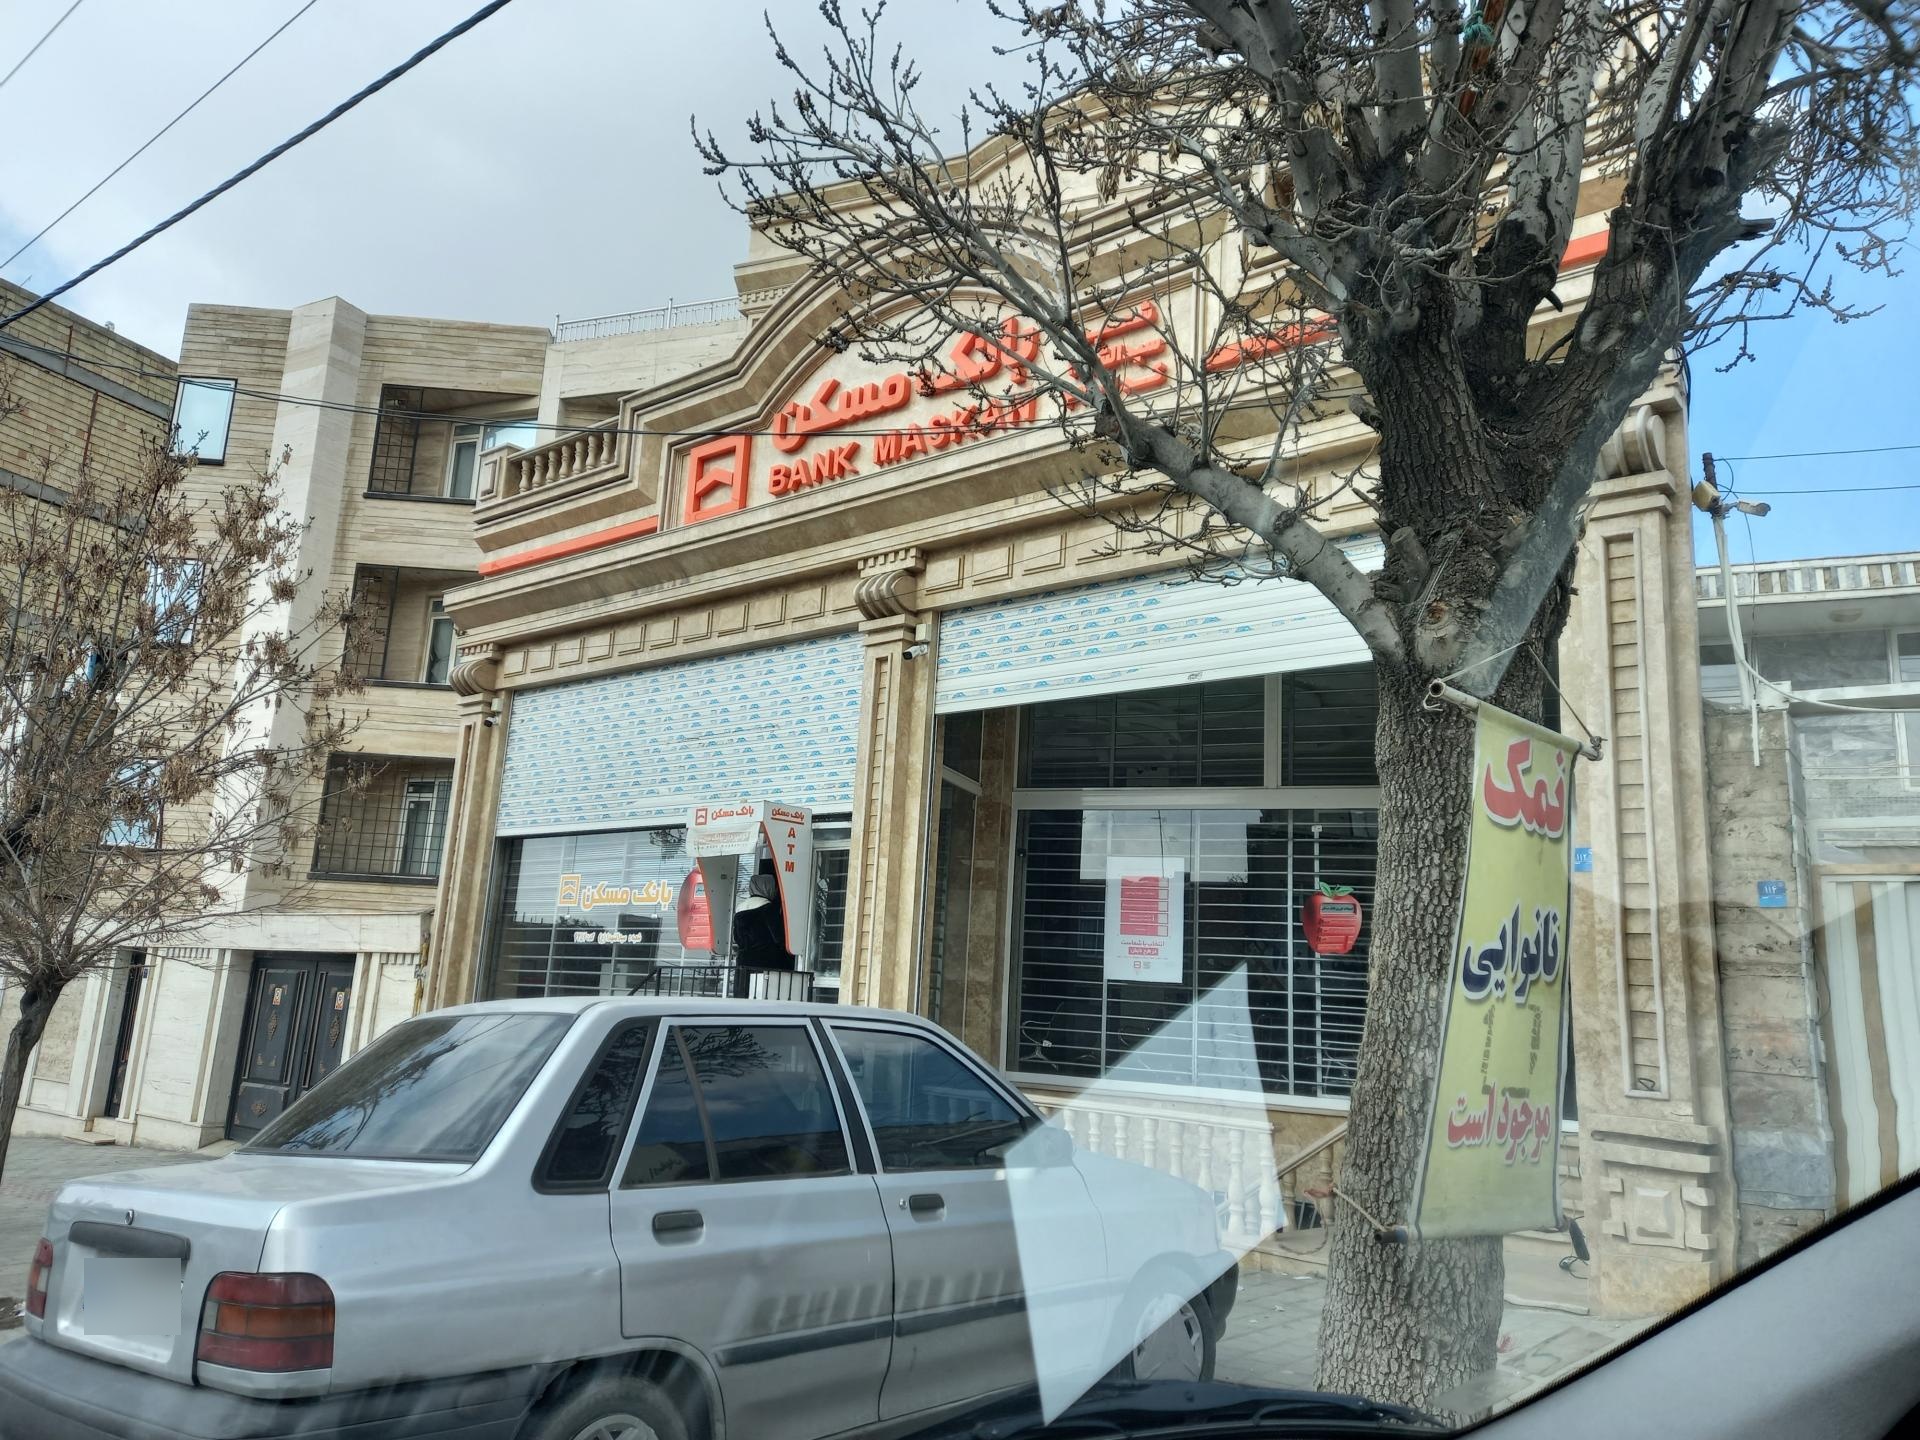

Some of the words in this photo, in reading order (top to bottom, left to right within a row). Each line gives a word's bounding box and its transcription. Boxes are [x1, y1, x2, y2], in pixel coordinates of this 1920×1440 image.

[914, 317, 1042, 398] بانک
[772, 373, 912, 453] مسکن
[768, 441, 861, 496] BANK
[873, 398, 1037, 468] MASKAN
[711, 808, 735, 820] مسکن
[735, 805, 754, 817] بانک
[771, 808, 790, 818] مسکن
[1483, 737, 1566, 837] نمک
[790, 810, 805, 822] بانک
[785, 827, 796, 873] ATM
[581, 880, 630, 911] مسکن
[631, 879, 673, 911] بانک
[1462, 903, 1560, 1000] نانوایی
[1447, 1082, 1497, 1148] است
[1496, 1093, 1551, 1163] موجود
